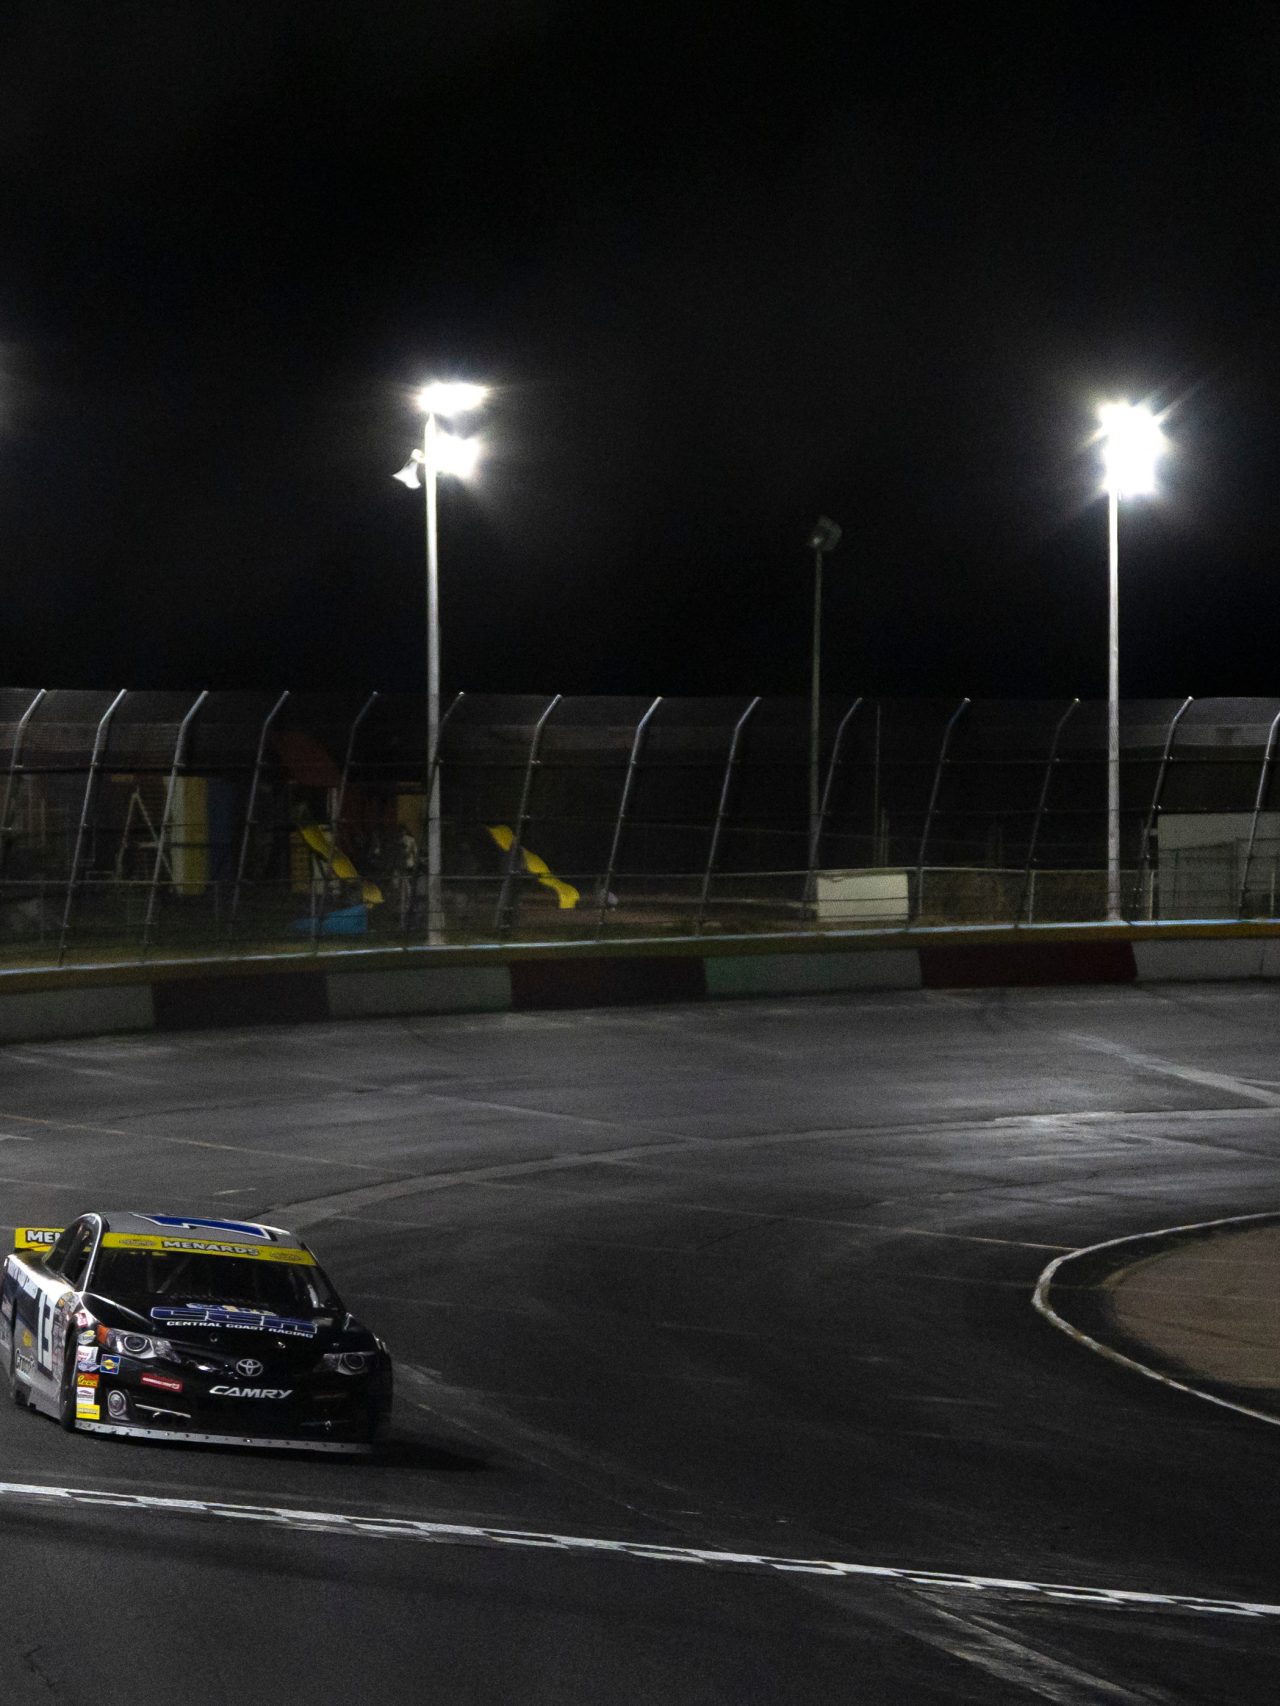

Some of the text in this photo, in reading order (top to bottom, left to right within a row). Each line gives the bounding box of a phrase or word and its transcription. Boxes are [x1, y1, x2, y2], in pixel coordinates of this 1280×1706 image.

[163, 1240, 260, 1256] MENARDS
[268, 1328, 314, 1339] RACING
[209, 1385, 294, 1399] CAMRY
